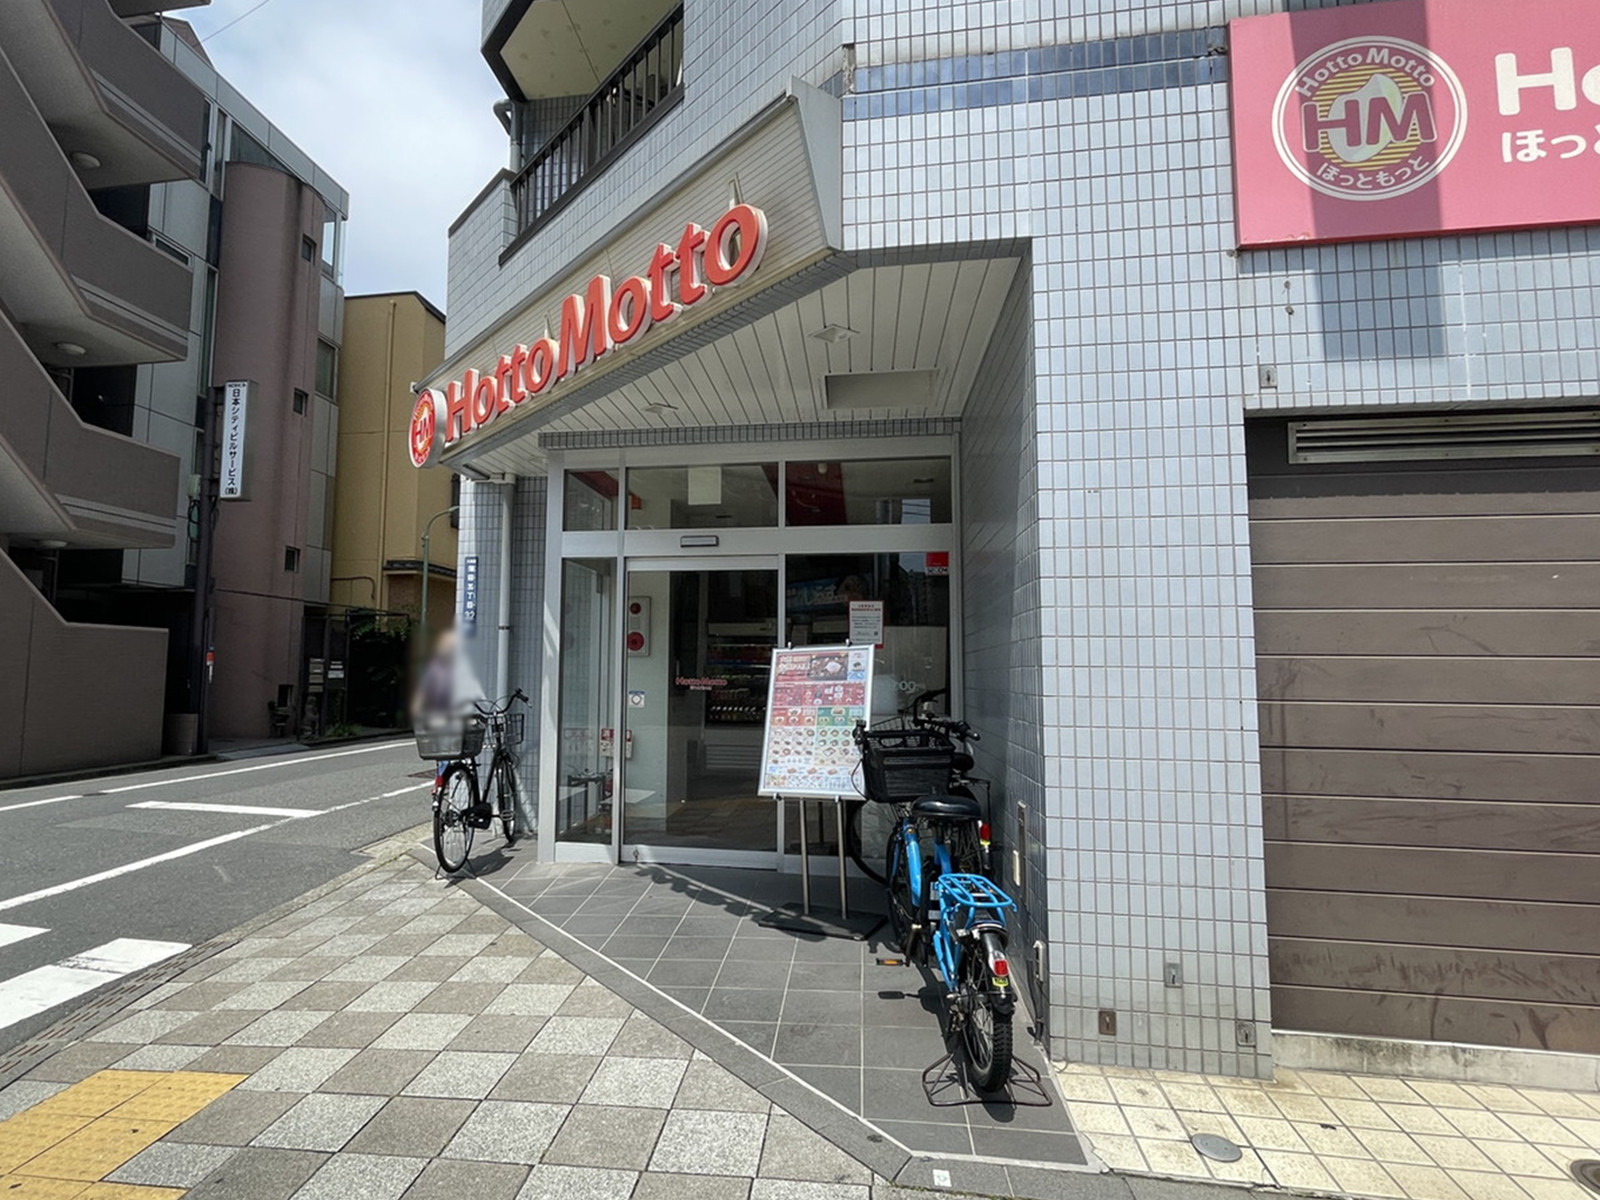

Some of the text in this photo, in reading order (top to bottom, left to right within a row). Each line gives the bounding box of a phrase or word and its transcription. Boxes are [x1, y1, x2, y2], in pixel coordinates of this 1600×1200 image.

[1302, 91, 1437, 152] HM
[1316, 155, 1429, 189] ほっともっと
